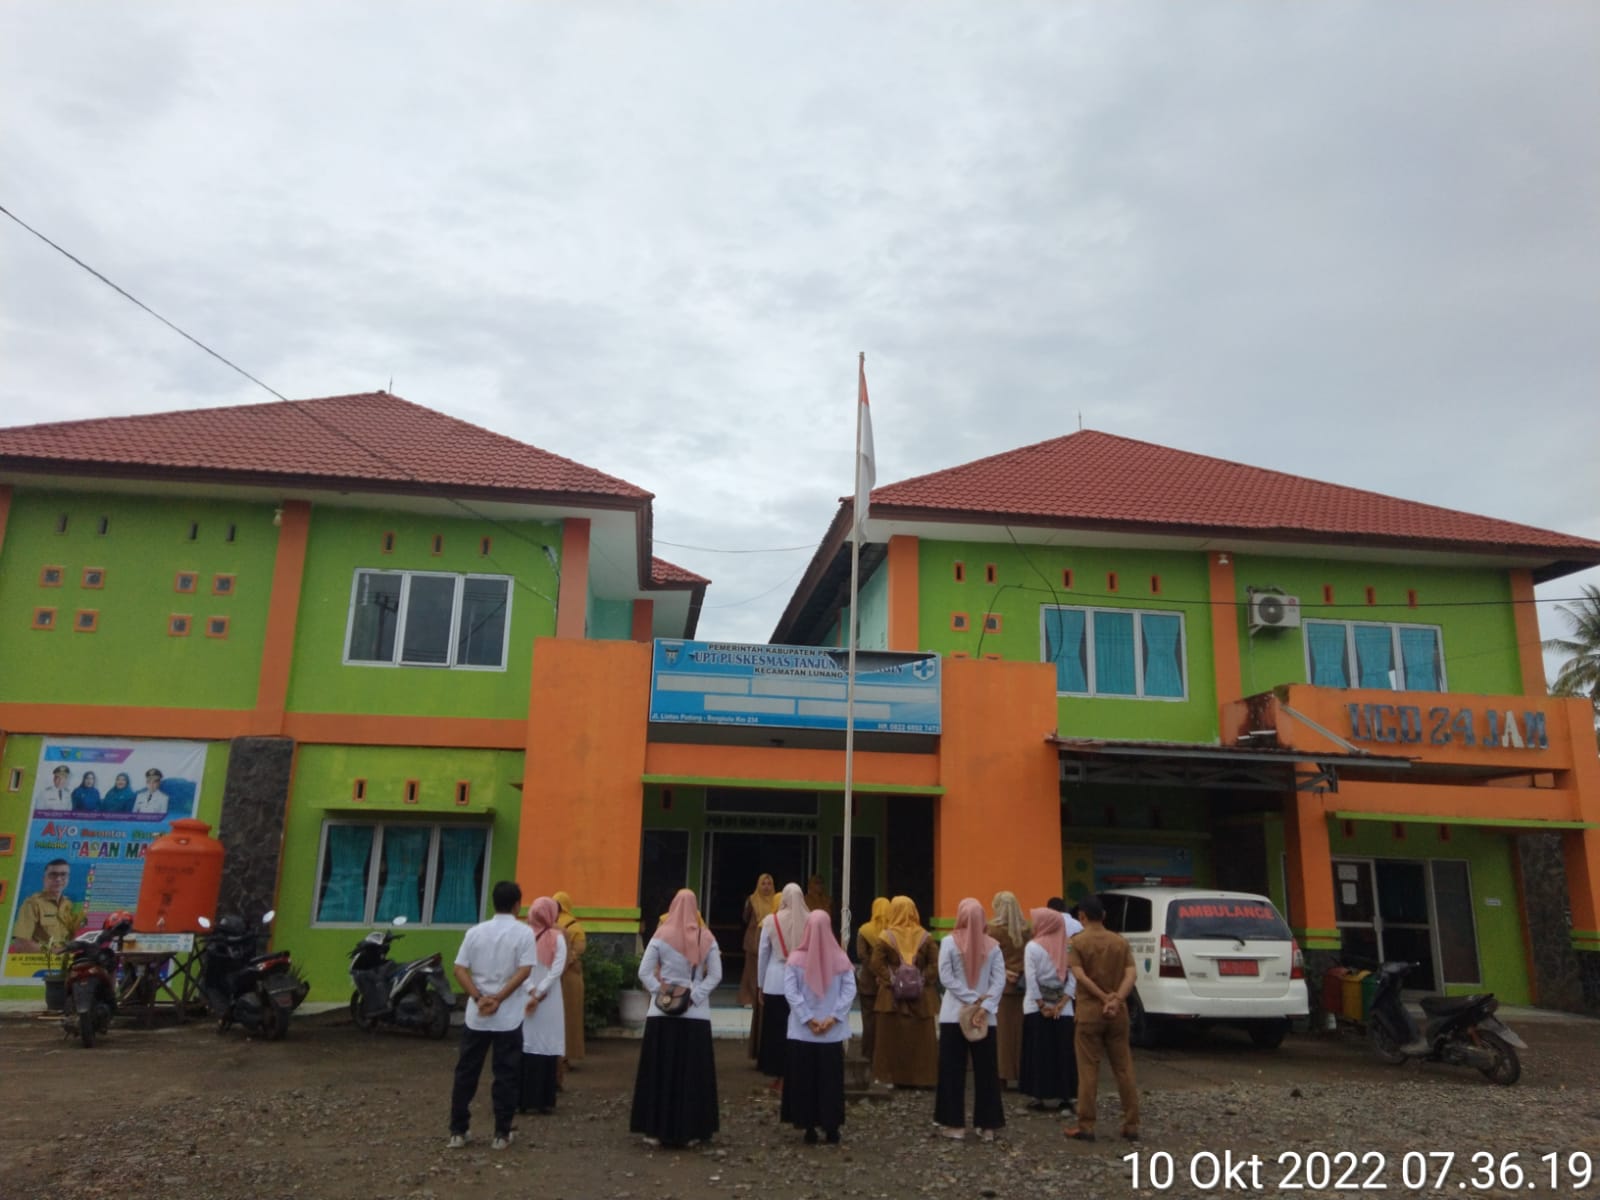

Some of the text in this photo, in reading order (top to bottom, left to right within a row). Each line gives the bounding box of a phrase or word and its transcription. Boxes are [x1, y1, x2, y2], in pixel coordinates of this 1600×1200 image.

[708, 644, 763, 653] PEMERINTAH
[765, 647, 816, 656] KABUPATEN
[694, 652, 718, 663] UPT
[720, 653, 790, 667] PUSKESMAS
[754, 667, 806, 677] KECAMATAN
[1429, 706, 1475, 746] 24
[1483, 710, 1548, 749] JAM
[42, 821, 78, 840] Ayo
[1178, 905, 1275, 920] AMBULANCE
